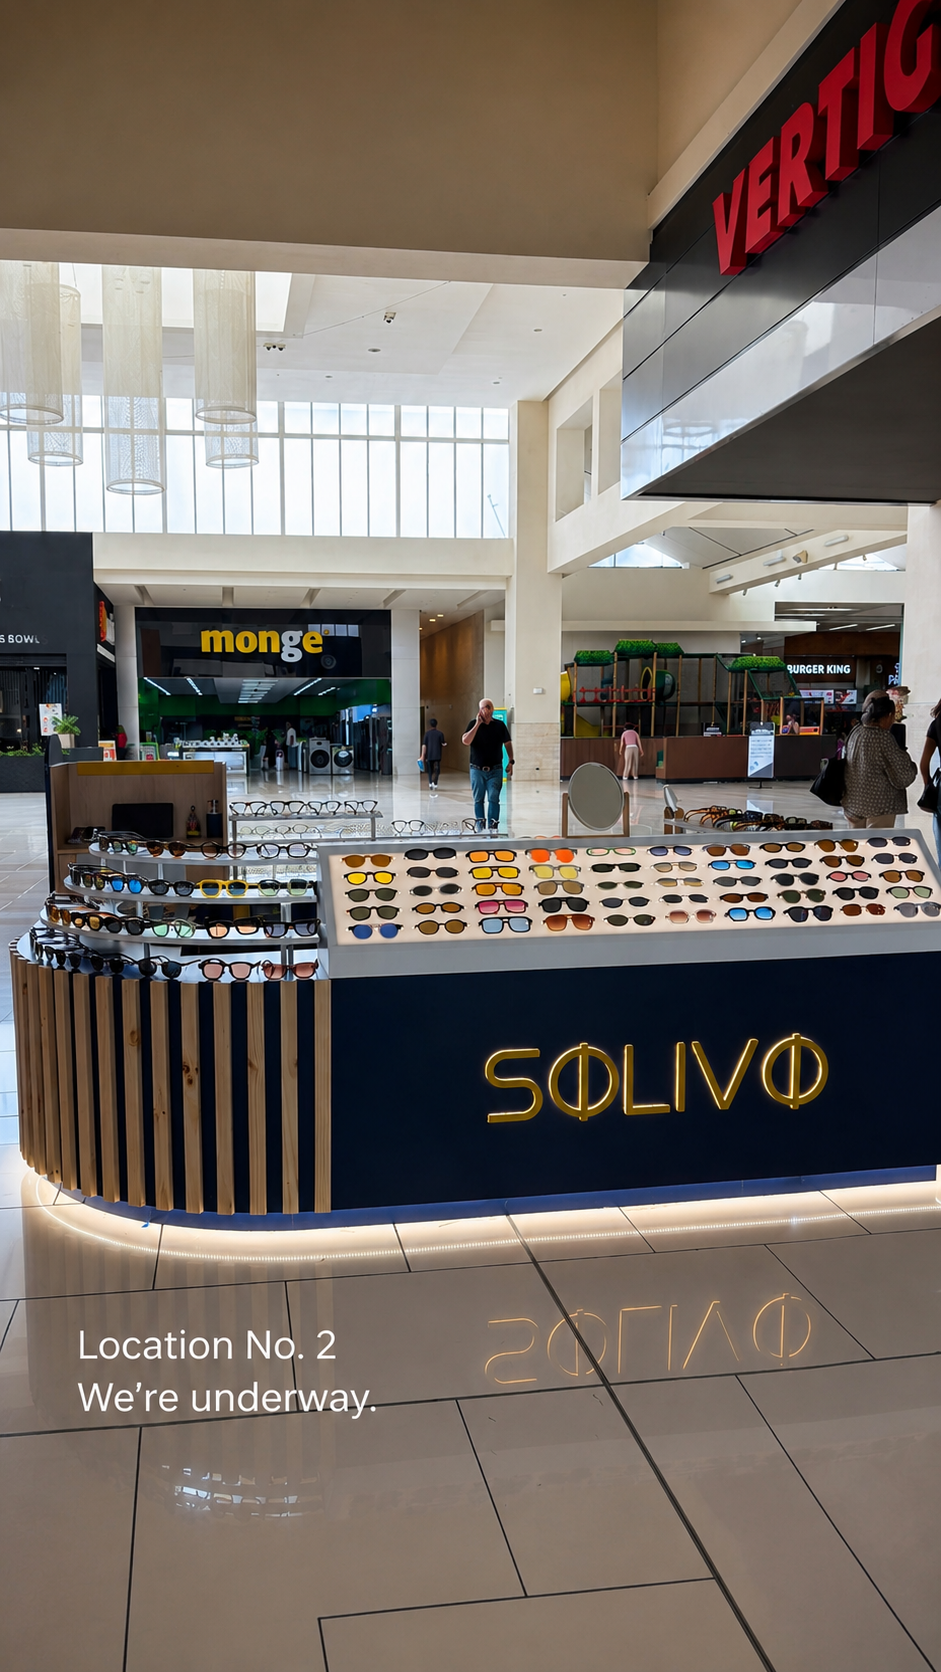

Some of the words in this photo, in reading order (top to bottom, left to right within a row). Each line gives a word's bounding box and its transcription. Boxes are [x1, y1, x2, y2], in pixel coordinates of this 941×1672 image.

[201, 629, 323, 663] monge
[787, 664, 825, 674] BURGER
[826, 664, 851, 674] KING
[485, 1033, 829, 1123] SOLIVO
